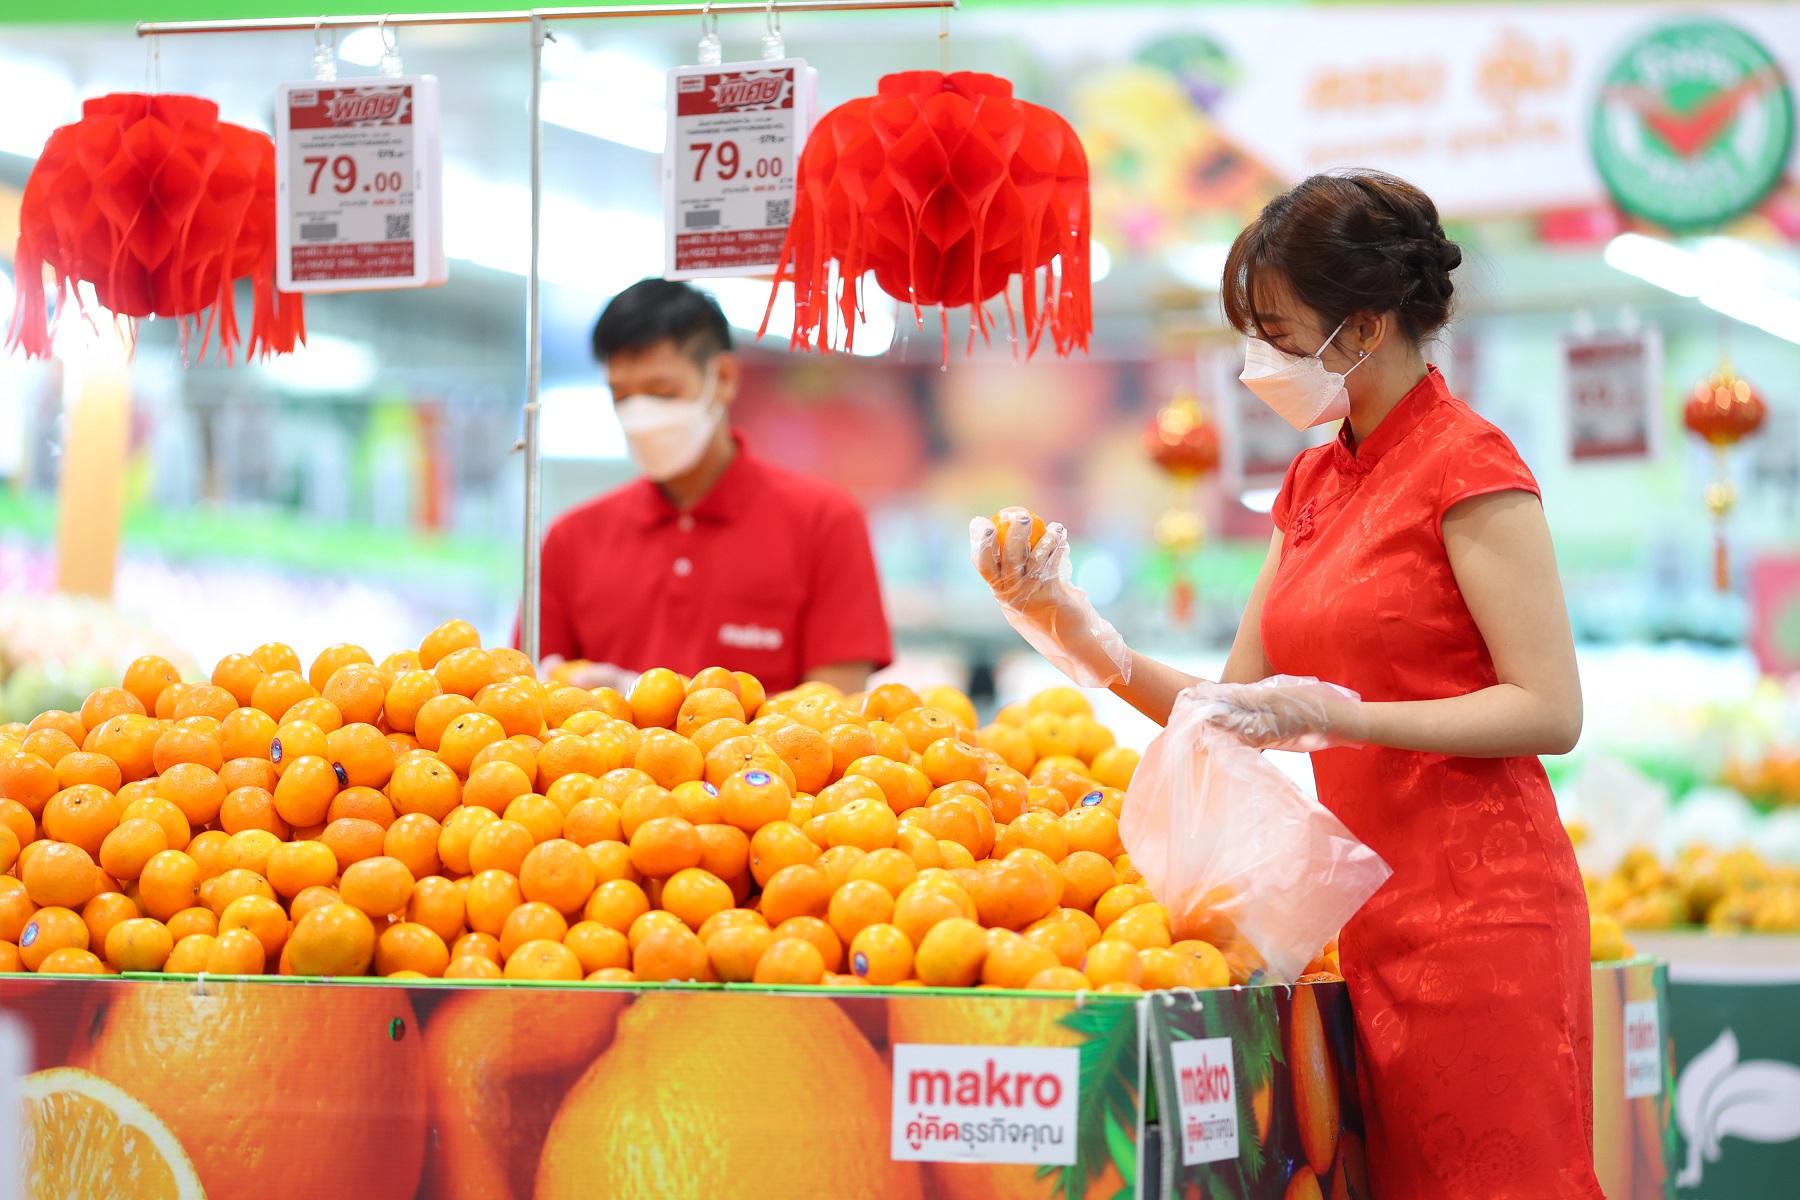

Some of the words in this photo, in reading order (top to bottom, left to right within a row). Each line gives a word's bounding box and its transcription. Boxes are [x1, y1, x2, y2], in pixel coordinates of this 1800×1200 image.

[332, 91, 402, 124] พิเศษ
[718, 76, 782, 107] พิเศษ
[303, 153, 402, 195] 79.00
[689, 140, 782, 182] 79.00
[908, 1058, 1062, 1108] makro
[1180, 1051, 1230, 1106] makro
[906, 1112, 1064, 1153] คู่คิดธุรกิจคุณ
